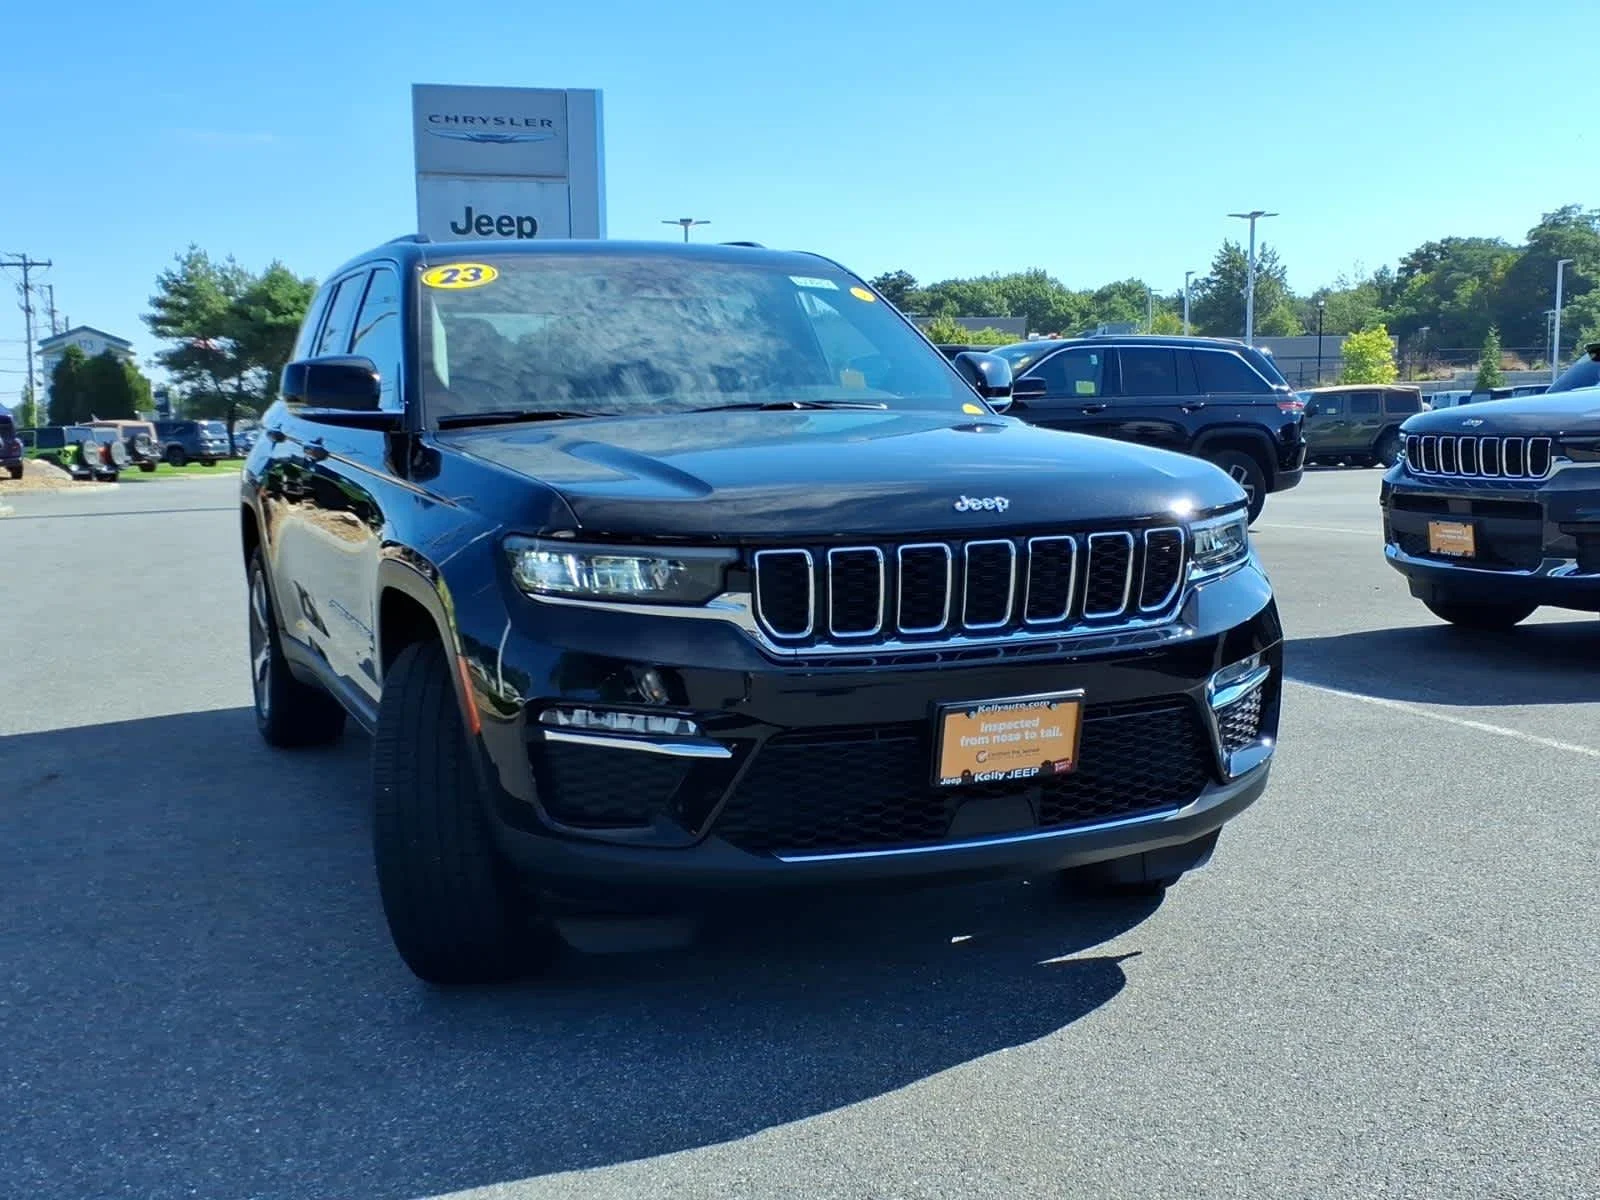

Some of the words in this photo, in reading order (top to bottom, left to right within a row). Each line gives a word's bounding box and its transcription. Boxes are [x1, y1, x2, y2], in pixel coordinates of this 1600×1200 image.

[428, 114, 553, 128] CHRYSLER
[450, 206, 538, 239] Jeep
[440, 266, 482, 285] 23
[954, 495, 1009, 513] Jeep
[980, 716, 1040, 733] Inspected
[959, 734, 990, 748] from
[992, 732, 1021, 745] nose
[1024, 729, 1038, 741] to
[1040, 726, 1063, 738] tail.
[940, 776, 962, 785] Jeep
[974, 769, 1006, 783] Kelly
[1006, 767, 1040, 780] JEEP
